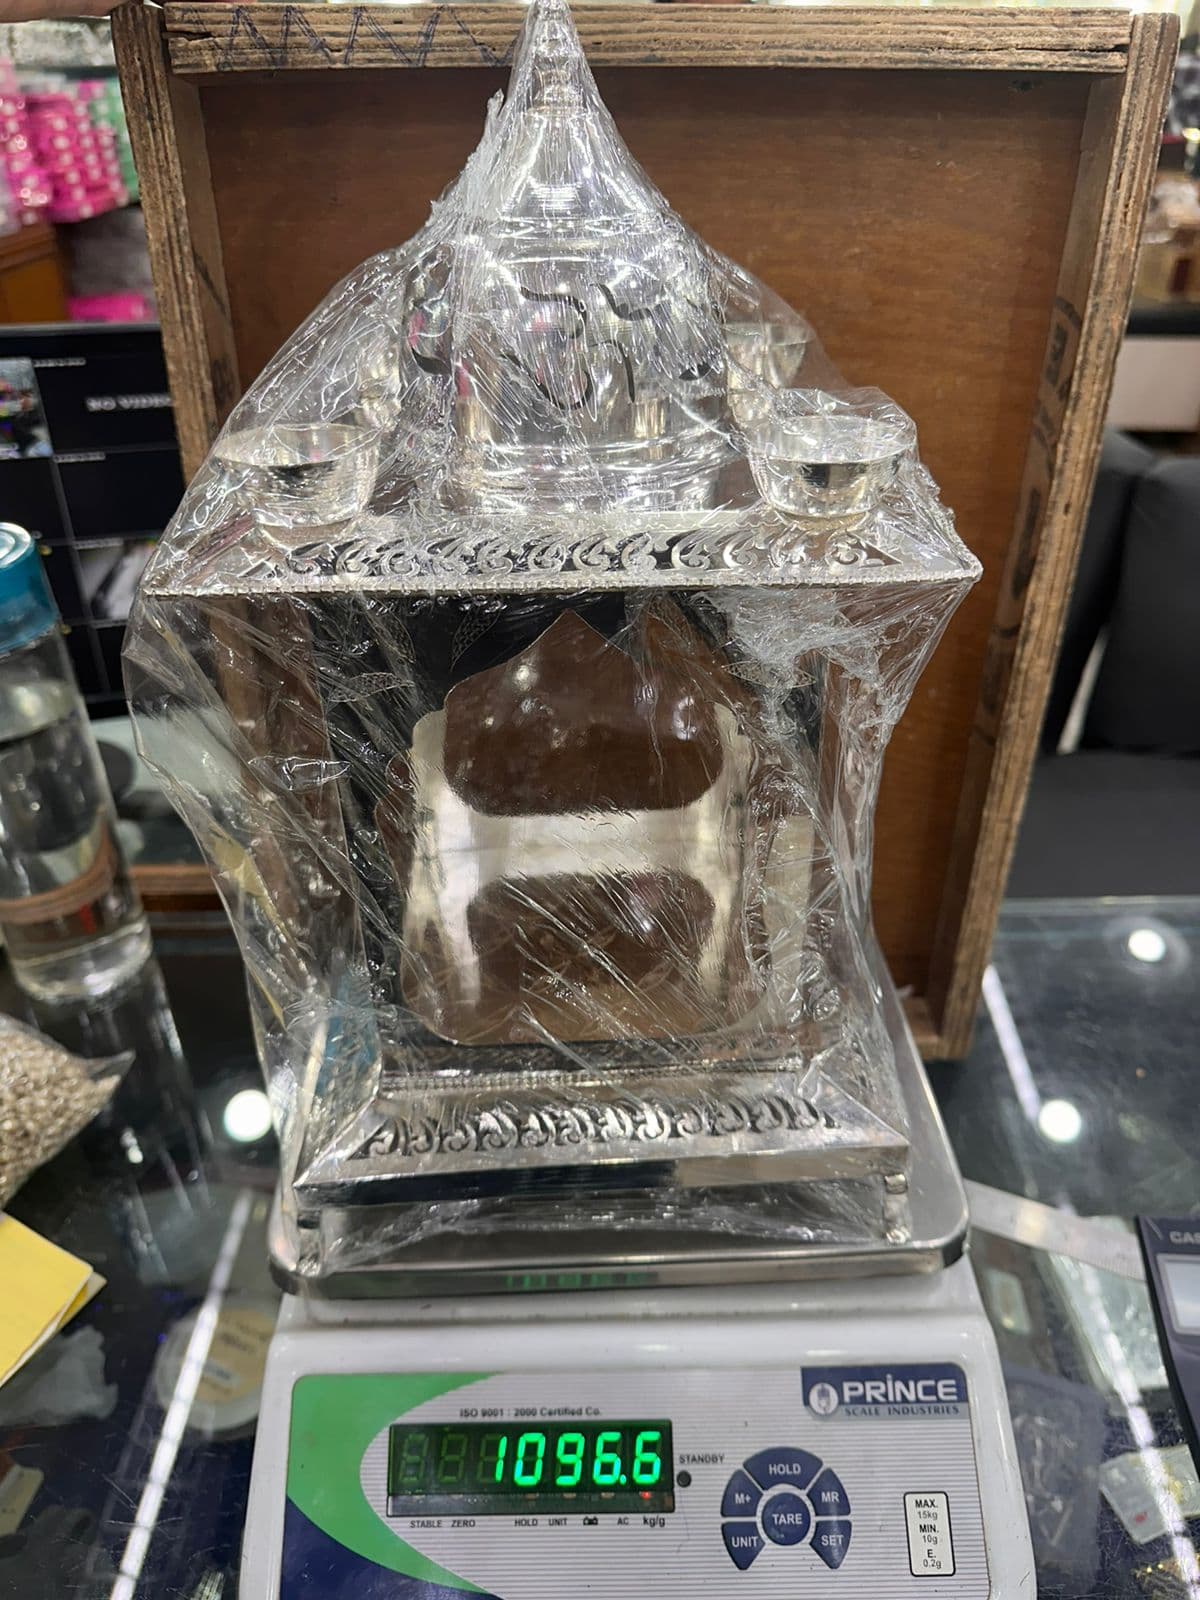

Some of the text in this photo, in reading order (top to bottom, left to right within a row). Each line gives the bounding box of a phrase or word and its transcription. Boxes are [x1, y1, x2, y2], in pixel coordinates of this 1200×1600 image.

[842, 1373, 958, 1403] PRINCE
[459, 1408, 479, 1418] ISO
[481, 1408, 504, 1417] 9001
[513, 1407, 538, 1417] 2000
[540, 1406, 583, 1416] Certified
[585, 1406, 602, 1415] Co.
[844, 1404, 960, 1417] SCALE INDUSTRIES
[495, 1431, 662, 1486] 1096.6
[679, 1454, 725, 1464] STANDBY
[768, 1463, 801, 1475] HOLD
[735, 1493, 751, 1504] M+
[821, 1491, 840, 1502] MR
[915, 1499, 938, 1508] MAX.
[772, 1513, 803, 1525] TARE
[918, 1510, 938, 1520] 15kg
[410, 1516, 666, 1529] STABLE ZERO HOLD UNIT AC kg/g
[919, 1524, 939, 1533] MIN.
[731, 1536, 759, 1548] UNIT
[821, 1534, 844, 1546] SET
[923, 1534, 938, 1545] 10g
[927, 1549, 936, 1559] E.
[923, 1559, 942, 1570] 0.2g
